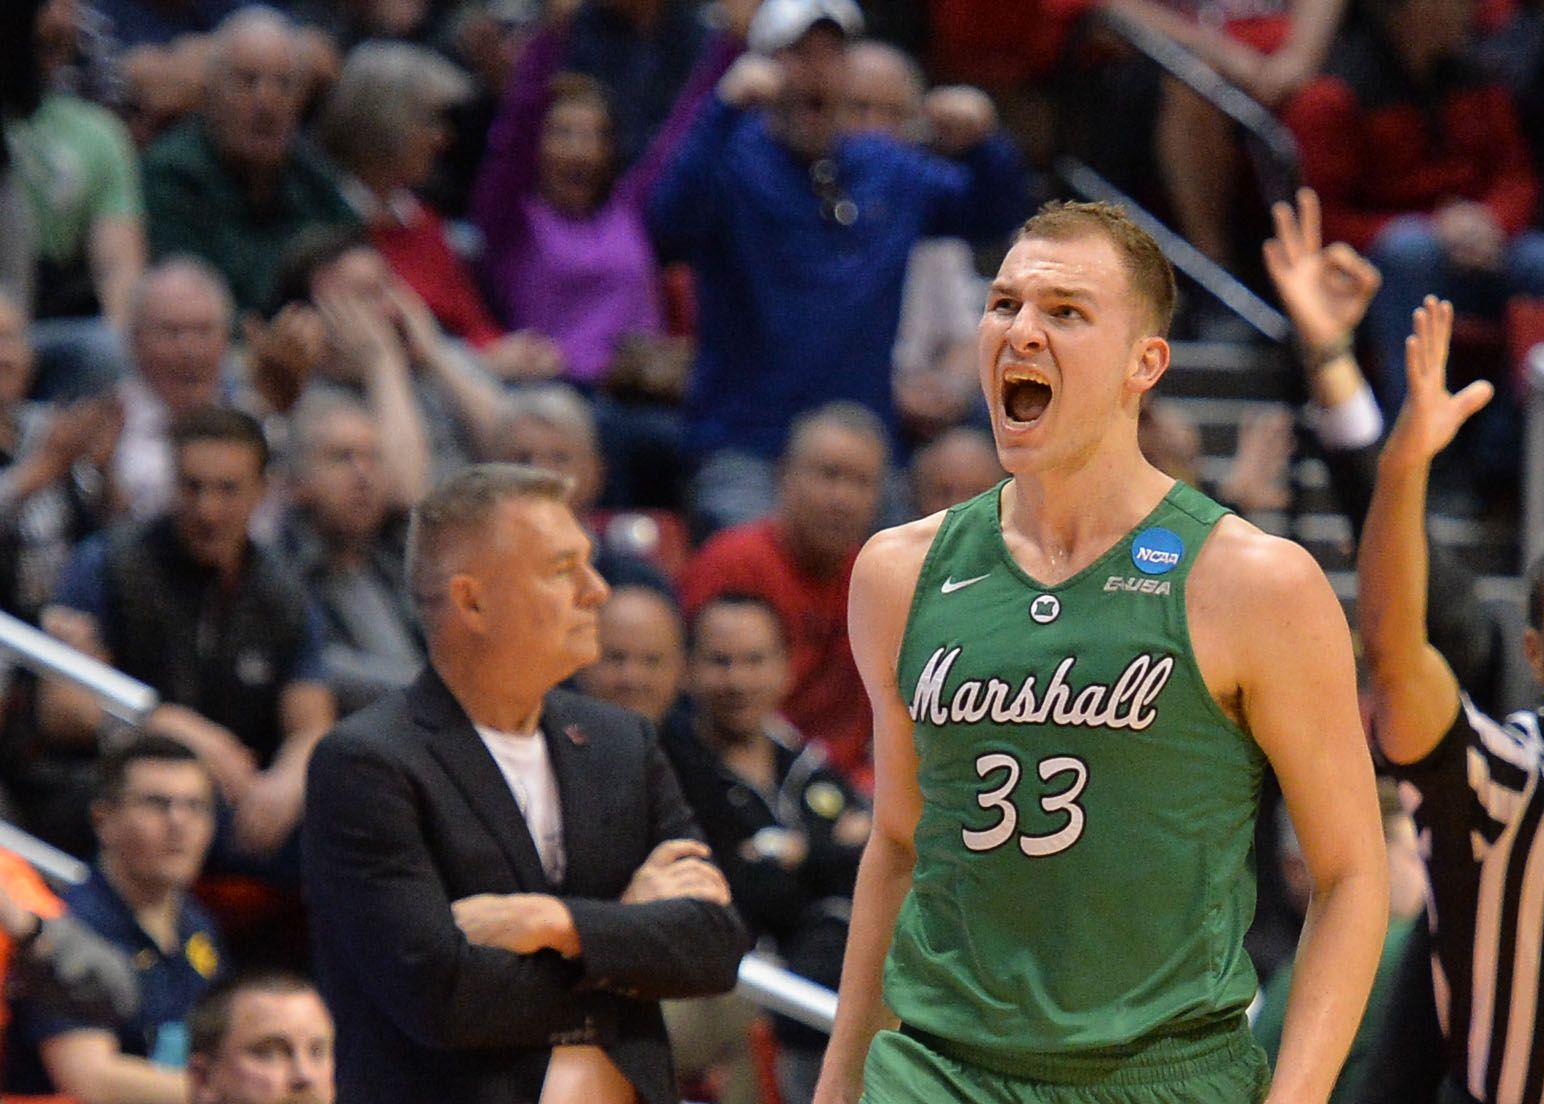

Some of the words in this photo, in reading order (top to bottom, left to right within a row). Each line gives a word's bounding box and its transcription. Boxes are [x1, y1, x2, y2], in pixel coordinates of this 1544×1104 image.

[1136, 547, 1179, 565] NCAA
[908, 646, 1175, 731] Marshall
[961, 753, 1090, 858] 33
